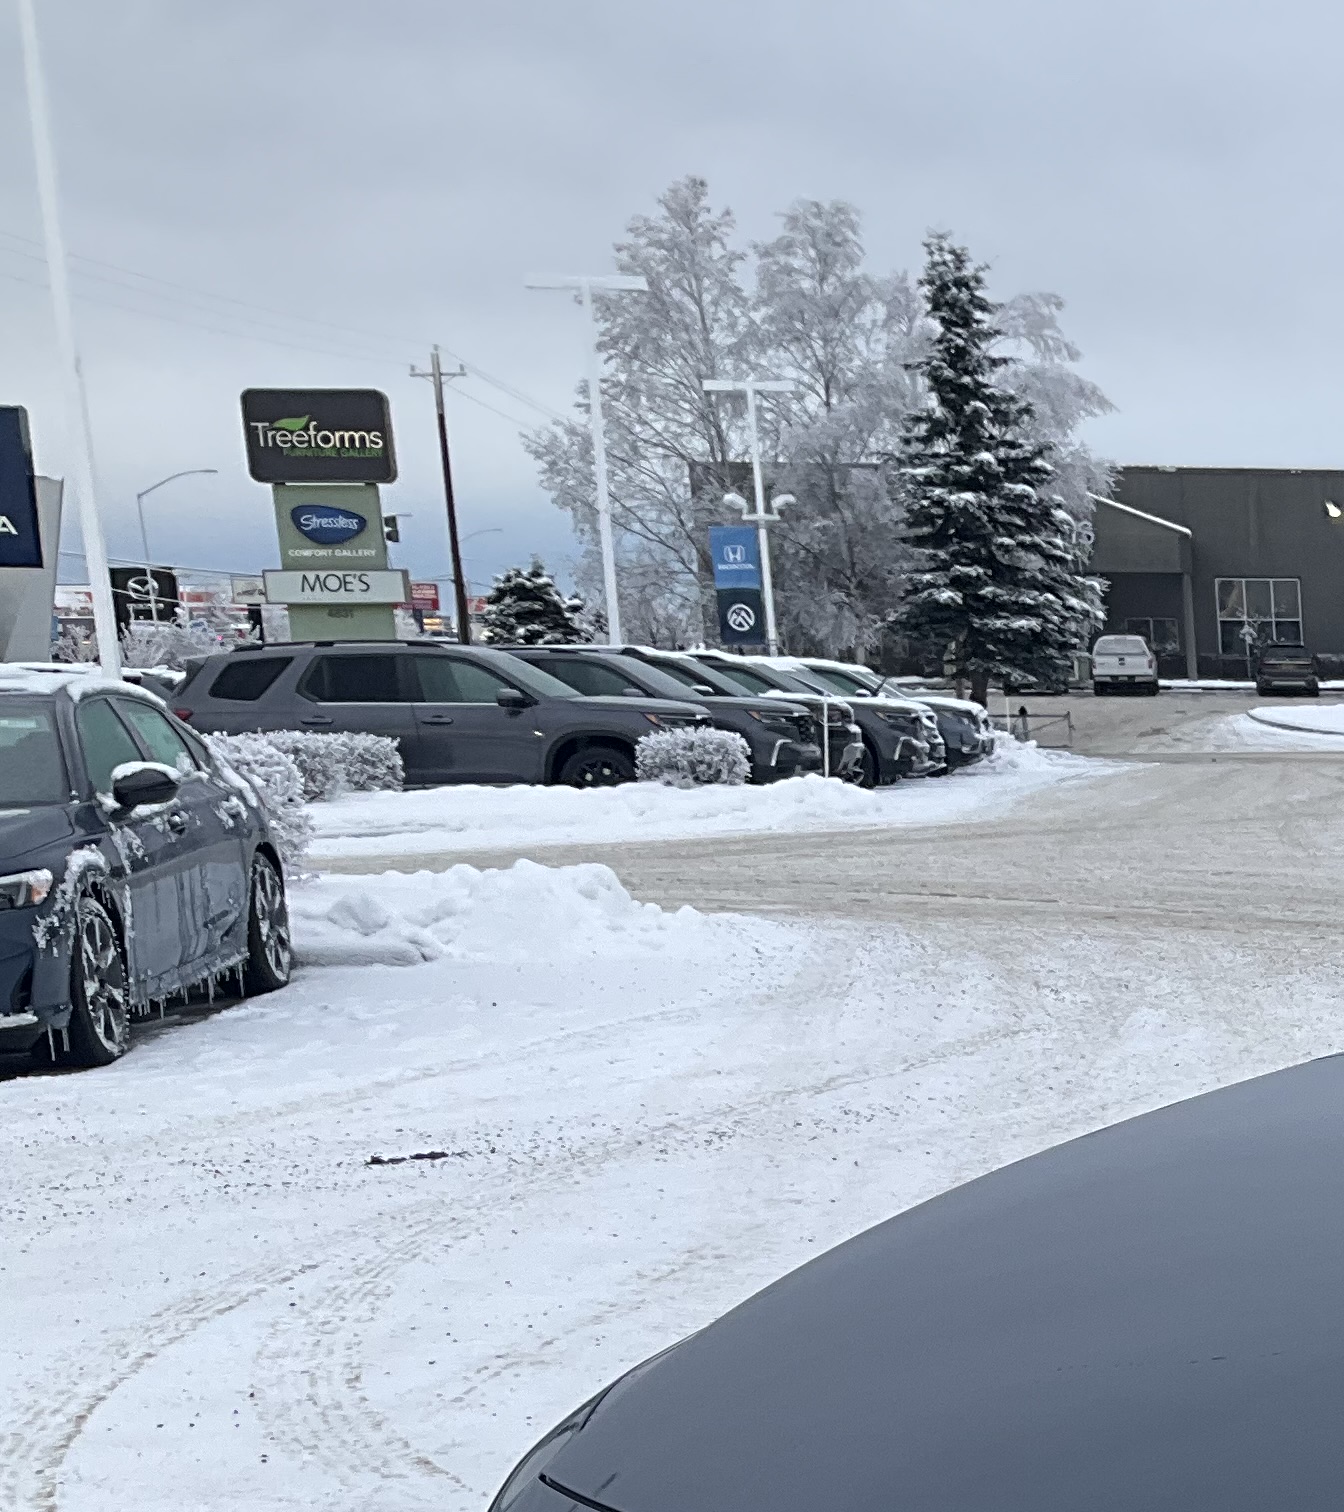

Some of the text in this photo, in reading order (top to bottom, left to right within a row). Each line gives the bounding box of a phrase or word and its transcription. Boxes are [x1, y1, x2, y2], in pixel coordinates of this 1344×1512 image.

[250, 421, 384, 448] Treeforms
[300, 514, 360, 531] Stressless
[288, 548, 377, 557] COMFORT GALLERY
[300, 573, 371, 593] MOE'S
